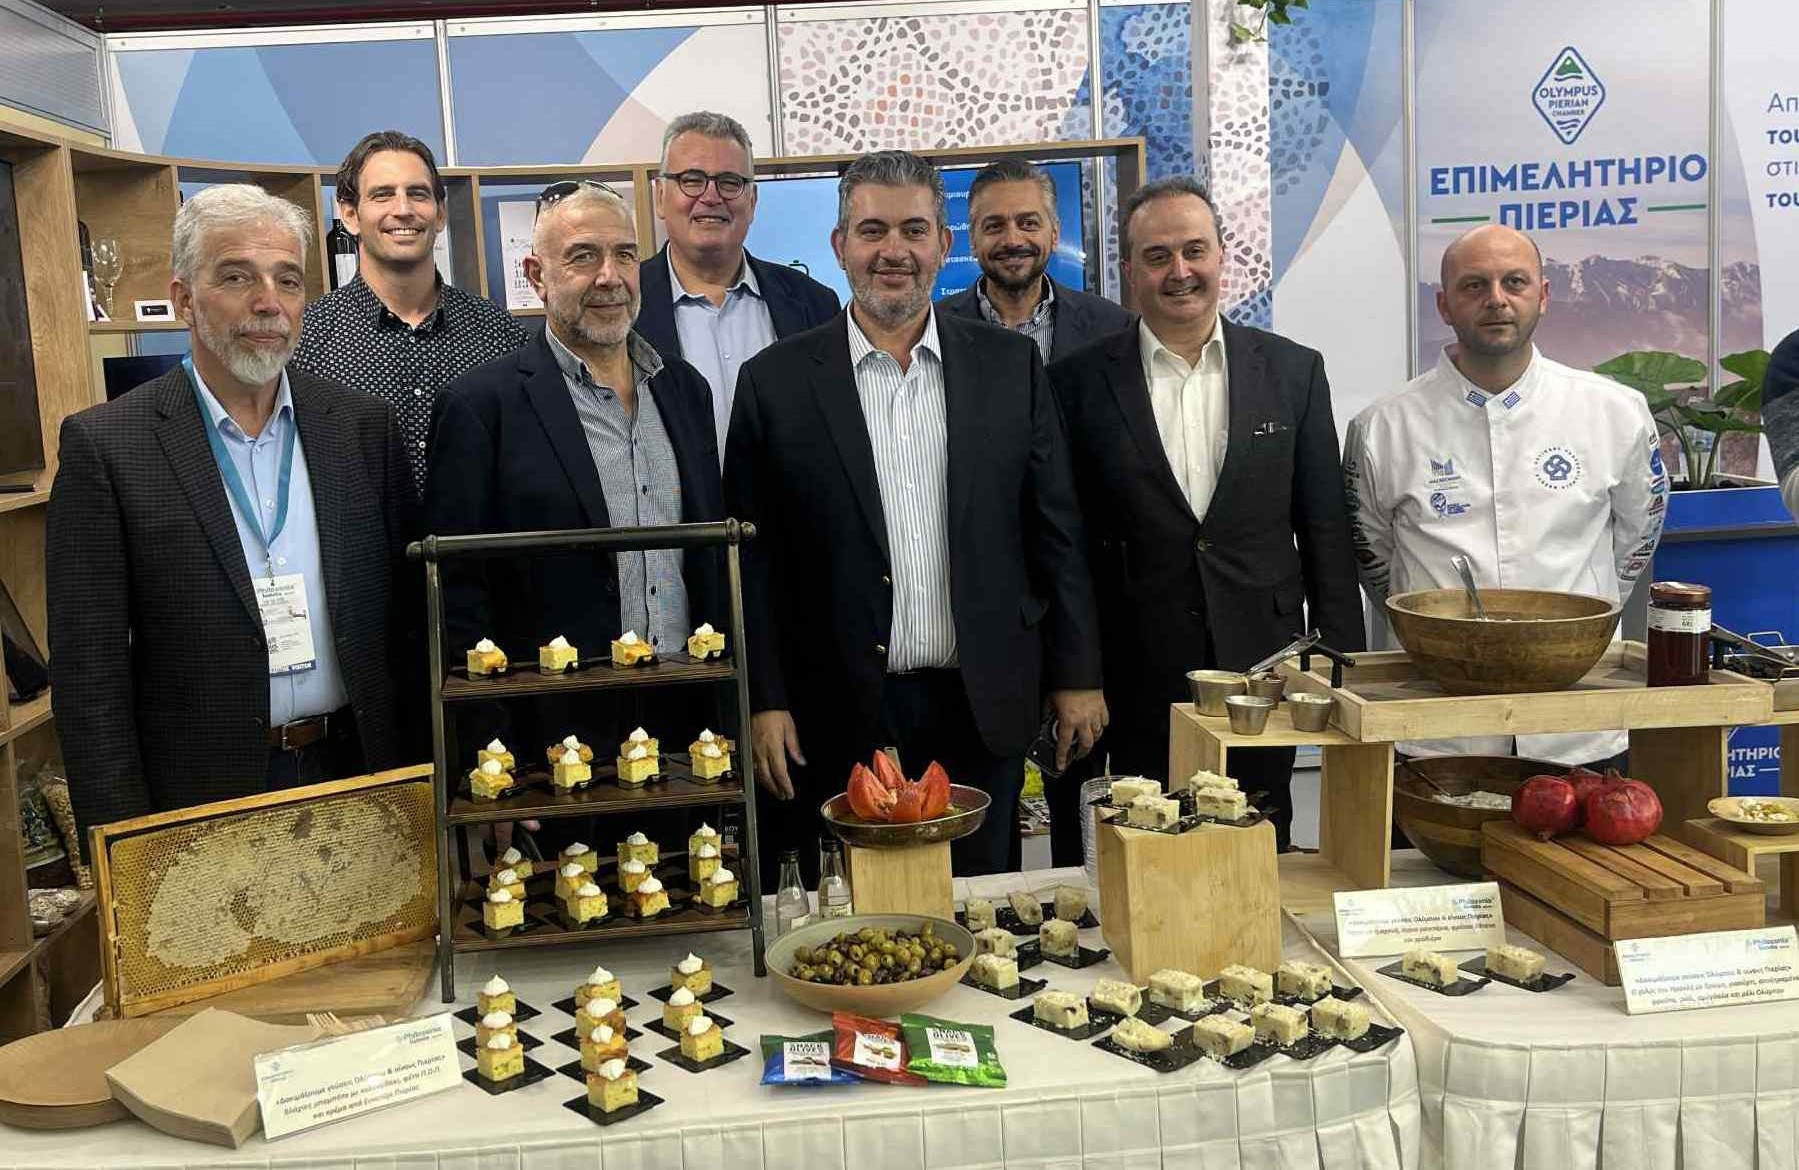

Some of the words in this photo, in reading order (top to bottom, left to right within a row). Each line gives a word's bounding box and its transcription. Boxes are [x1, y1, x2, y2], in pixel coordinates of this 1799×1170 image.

[1539, 85, 1598, 98] OLYMPUS
[1549, 99, 1588, 108] PIERIAN
[1767, 92, 1799, 113] Απ
[1430, 153, 1708, 196] ΕΠΙΜΕΛΗΤΗΡΙΟ
[1500, 197, 1638, 231] ΠΙΕΡΙΑΣ
[1728, 765, 1756, 778] ΙΑΣ
